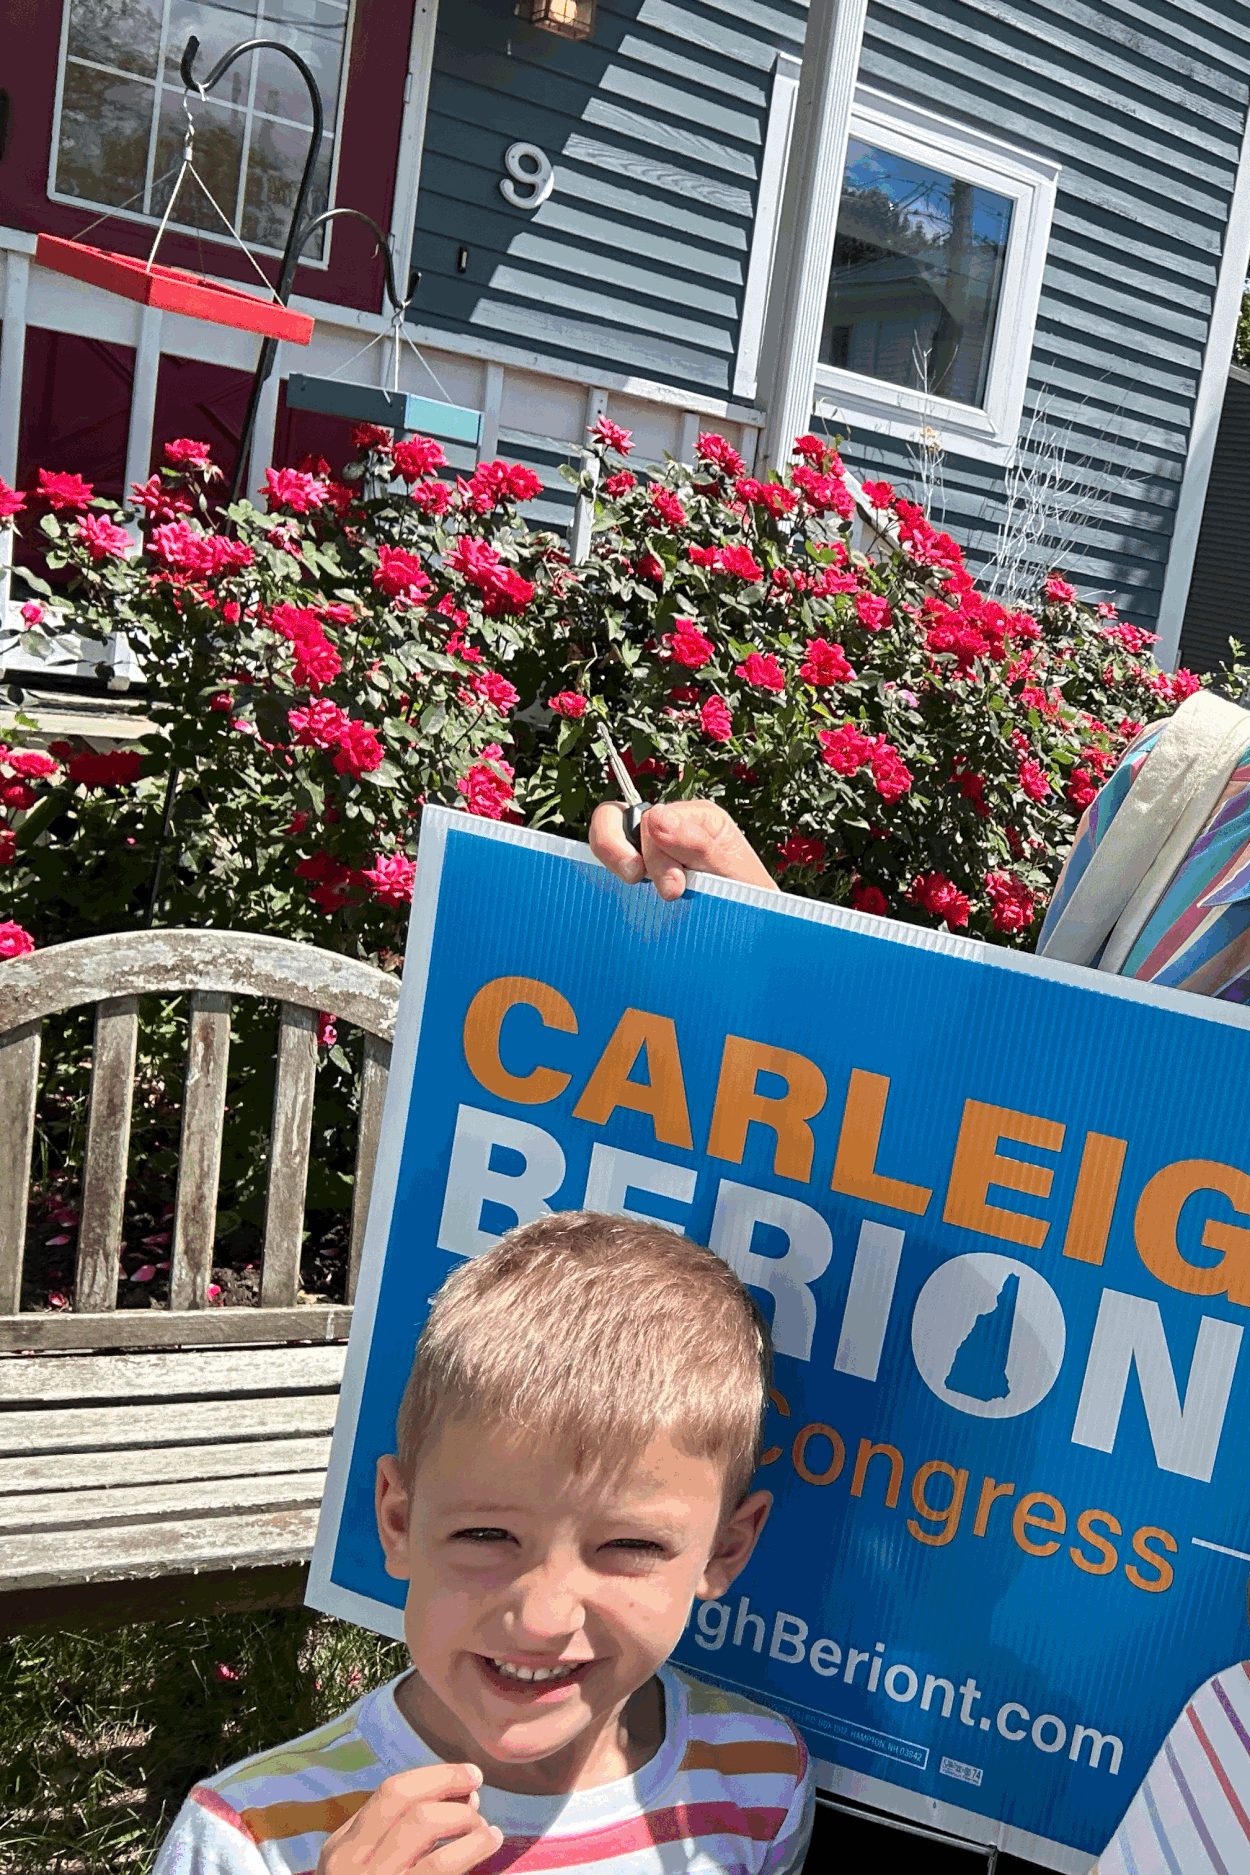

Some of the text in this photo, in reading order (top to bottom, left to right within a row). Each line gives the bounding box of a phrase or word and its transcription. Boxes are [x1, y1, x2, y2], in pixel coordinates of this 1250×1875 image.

[500, 141, 555, 210] 9
[760, 1386, 1178, 1593] ongress
[686, 1596, 1125, 1775] ghBeriont.com
[887, 1742, 899, 1754] NH
[900, 1747, 923, 1762] 03842
